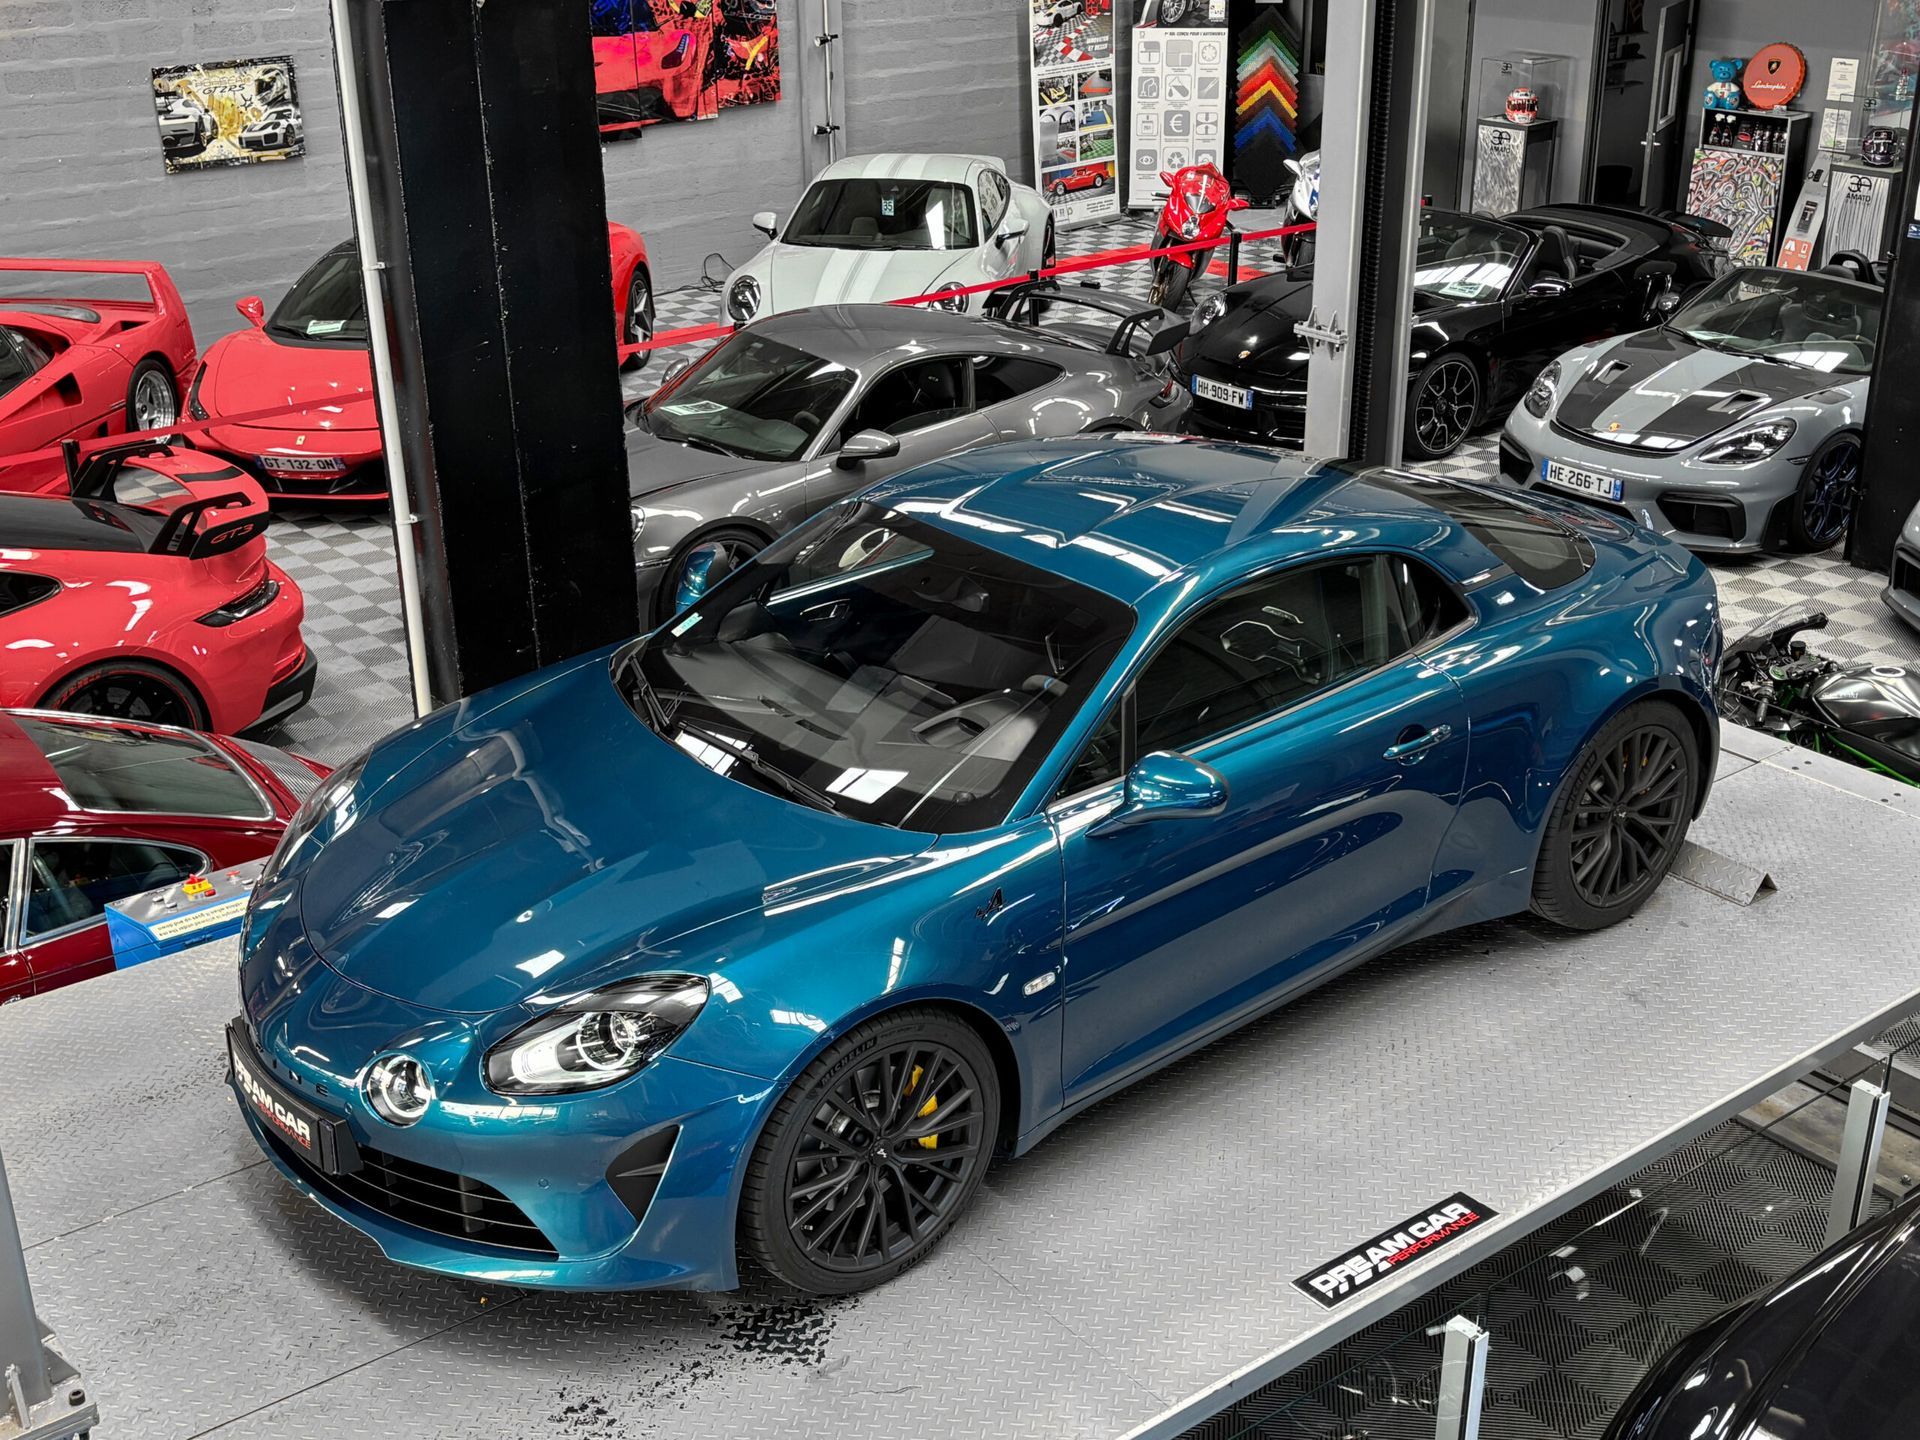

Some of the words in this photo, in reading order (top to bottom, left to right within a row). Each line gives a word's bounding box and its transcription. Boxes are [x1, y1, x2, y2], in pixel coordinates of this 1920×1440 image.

[1845, 192, 1871, 202] AMATO
[1197, 380, 1245, 405] HH-909-FW
[1549, 465, 1612, 494] HE-266-TJ
[210, 523, 255, 544] GT3
[820, 1036, 877, 1087] MICHELIN
[274, 1103, 311, 1141] CAR
[1308, 1231, 1413, 1298] DREAM
[1408, 1202, 1473, 1239] CAR
[1387, 1211, 1480, 1265] PERFORMANCE
